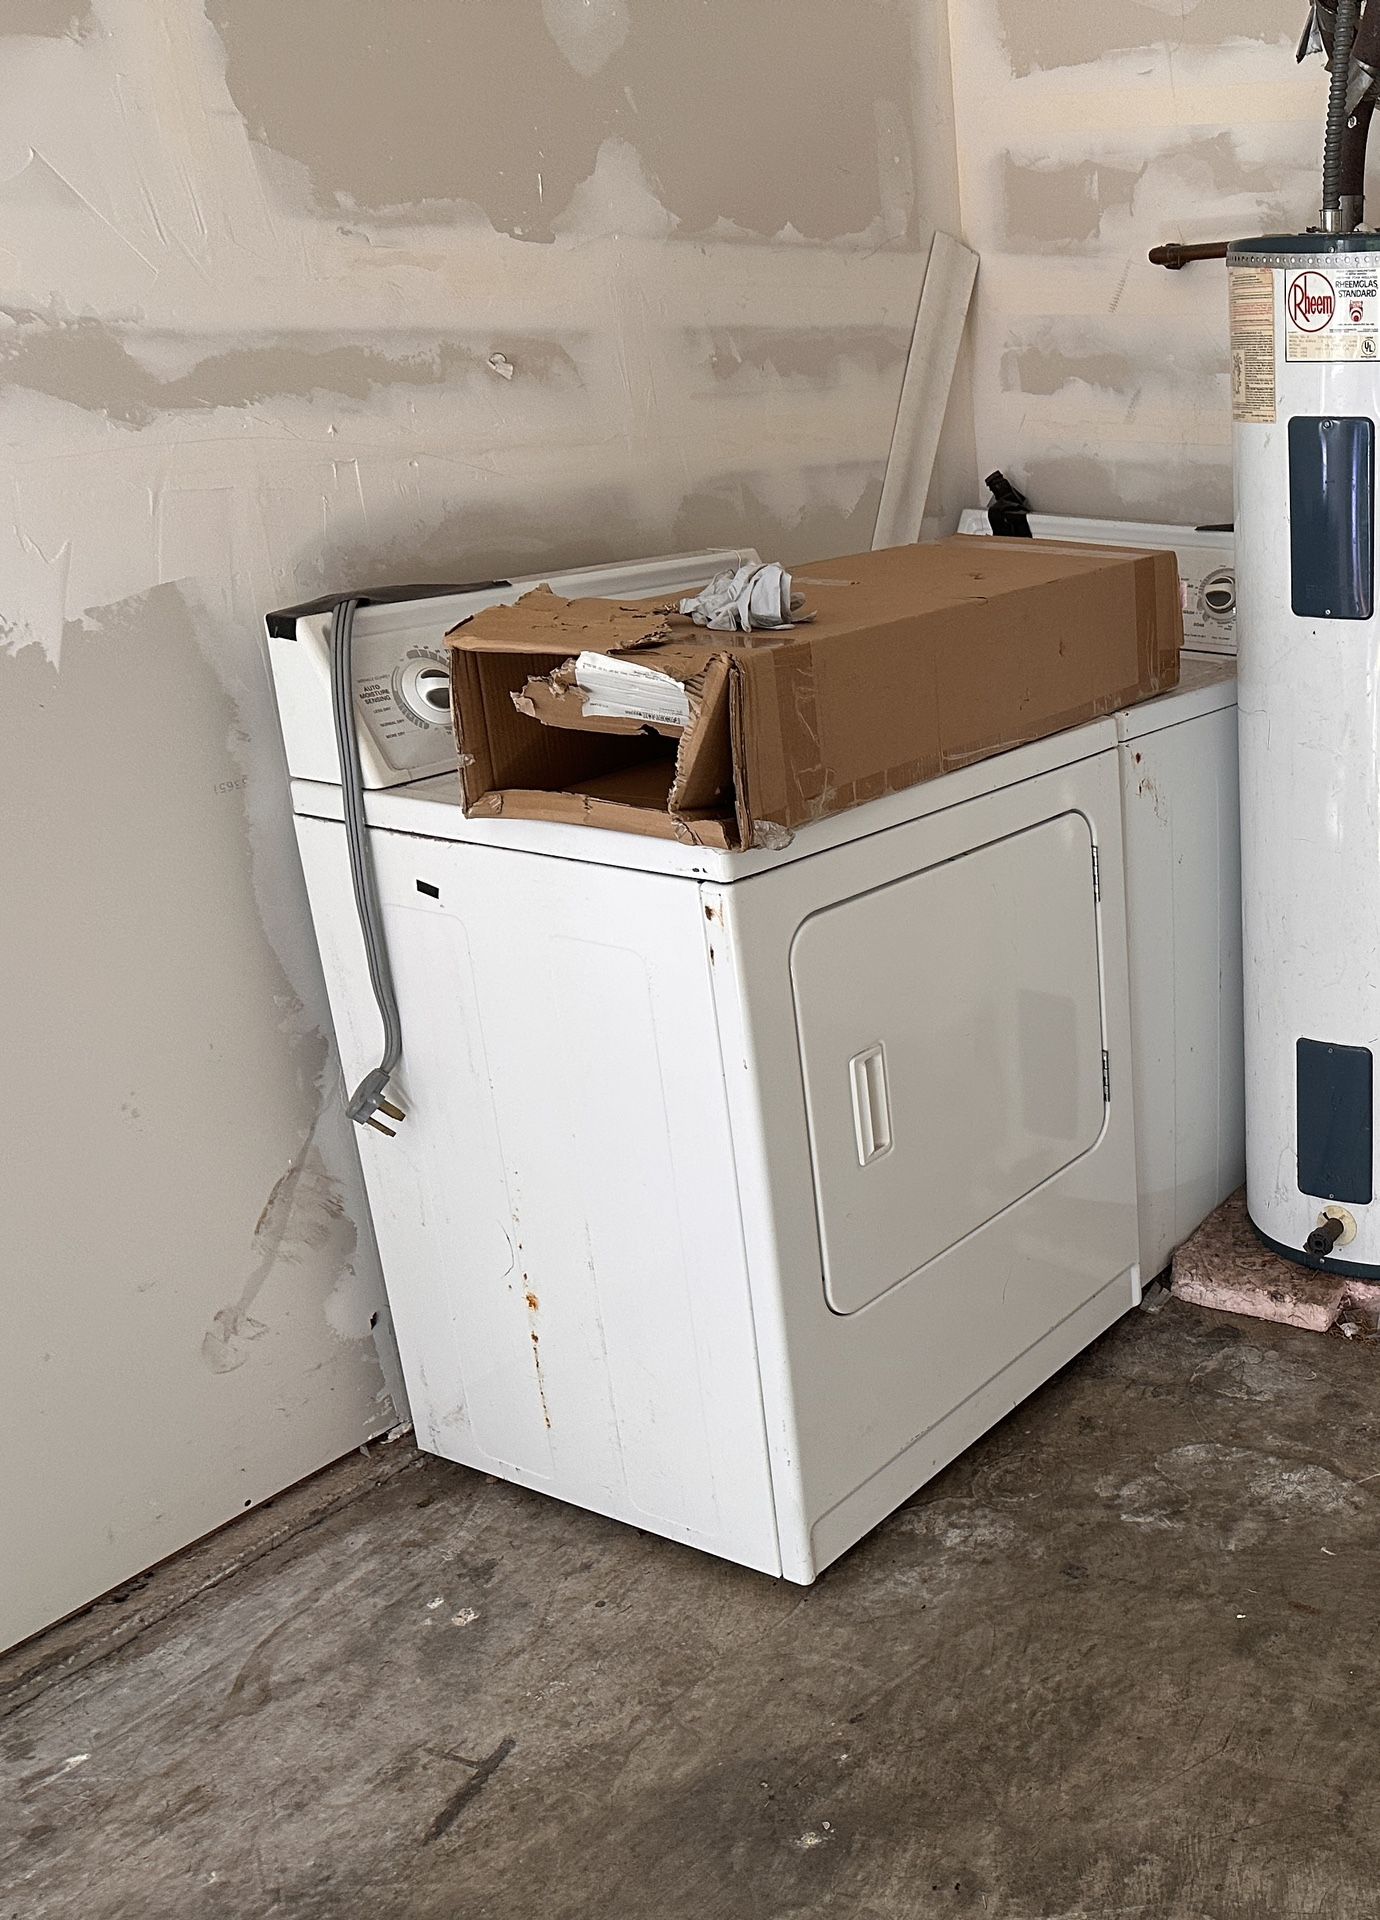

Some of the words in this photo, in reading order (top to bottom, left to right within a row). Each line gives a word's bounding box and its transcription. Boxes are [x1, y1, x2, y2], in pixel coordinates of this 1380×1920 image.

[1339, 289, 1377, 298] STANDARD
[1294, 275, 1332, 322] Rheem
[363, 684, 380, 692] AUTO
[360, 688, 390, 699] MOISTURE
[364, 695, 391, 704] SENSING
